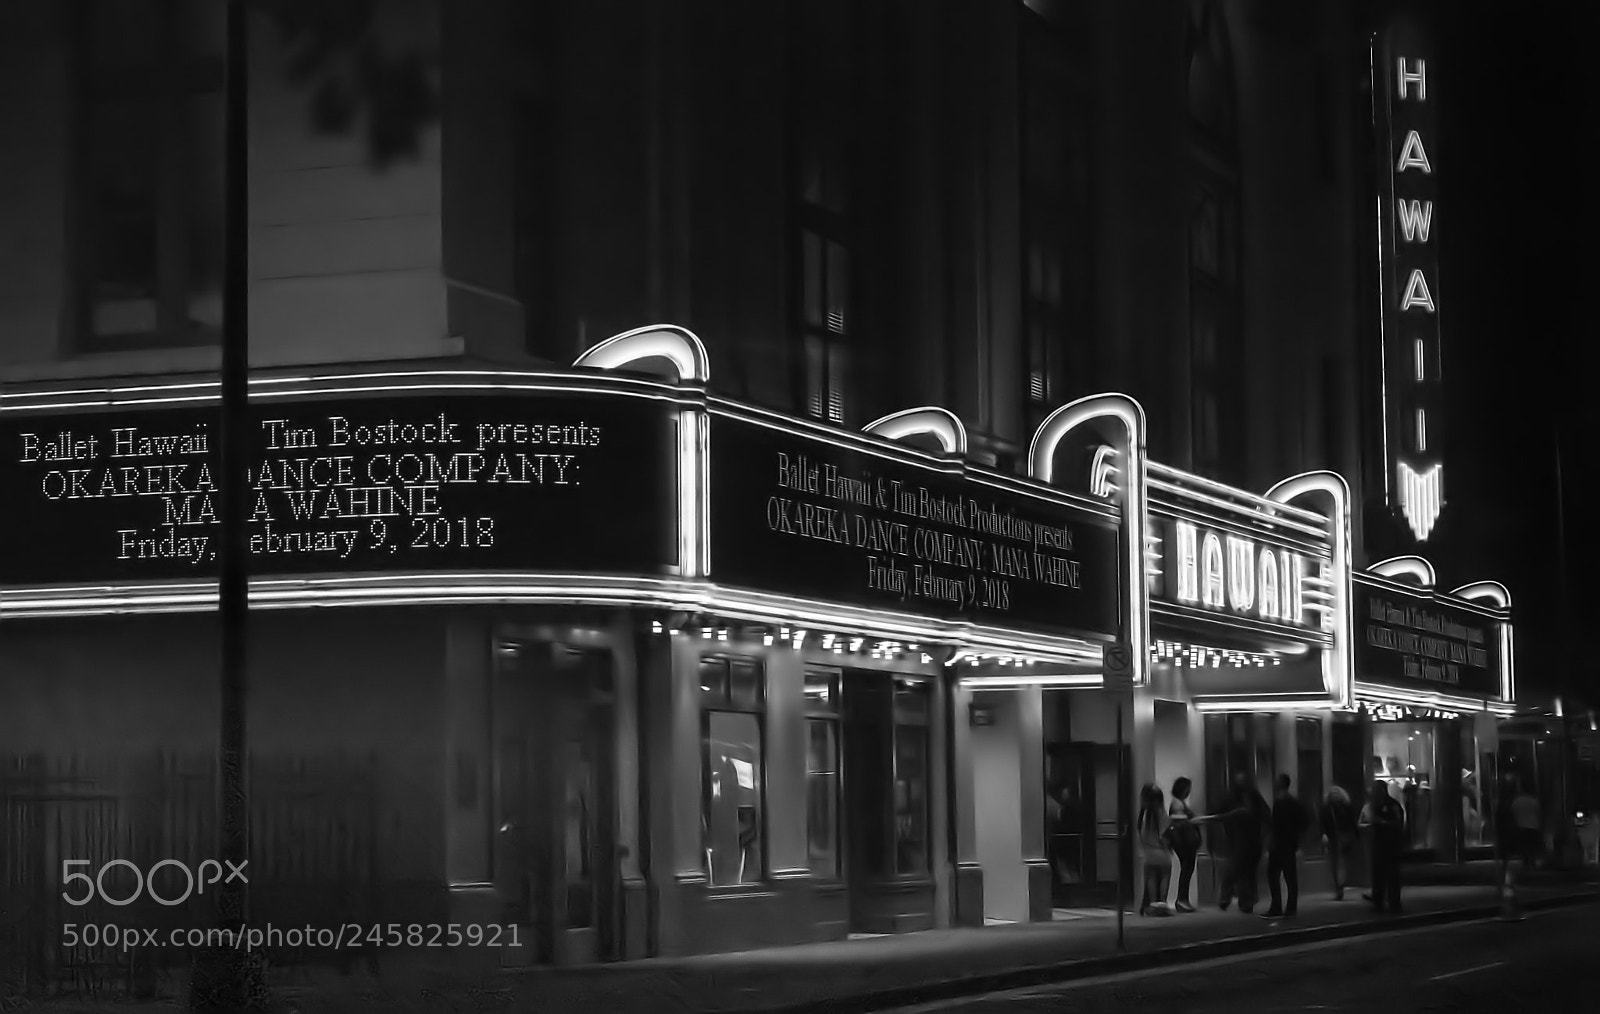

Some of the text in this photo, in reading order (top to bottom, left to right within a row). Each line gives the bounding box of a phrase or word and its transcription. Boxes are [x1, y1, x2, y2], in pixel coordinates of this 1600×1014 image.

[1397, 56, 1435, 452] HAWAII
[19, 412, 601, 463] Ballet Hawaii Tim Bostock presents
[42, 453, 582, 500] OKAREKA ANCE COMPANY:
[777, 451, 1074, 552] Ballet Hawaii & Tim Bostock Productions presents
[161, 486, 443, 526] MAA WAHINE
[117, 516, 495, 564] Friday, ebruary 9, 2018
[767, 496, 851, 545] OKAREKA
[855, 514, 909, 557] DANCE
[991, 543, 1031, 581] MANA
[1033, 552, 1082, 590] WAHINE
[914, 563, 966, 612] February
[982, 576, 1010, 611] 2018
[1175, 518, 1304, 624] HAWAII
